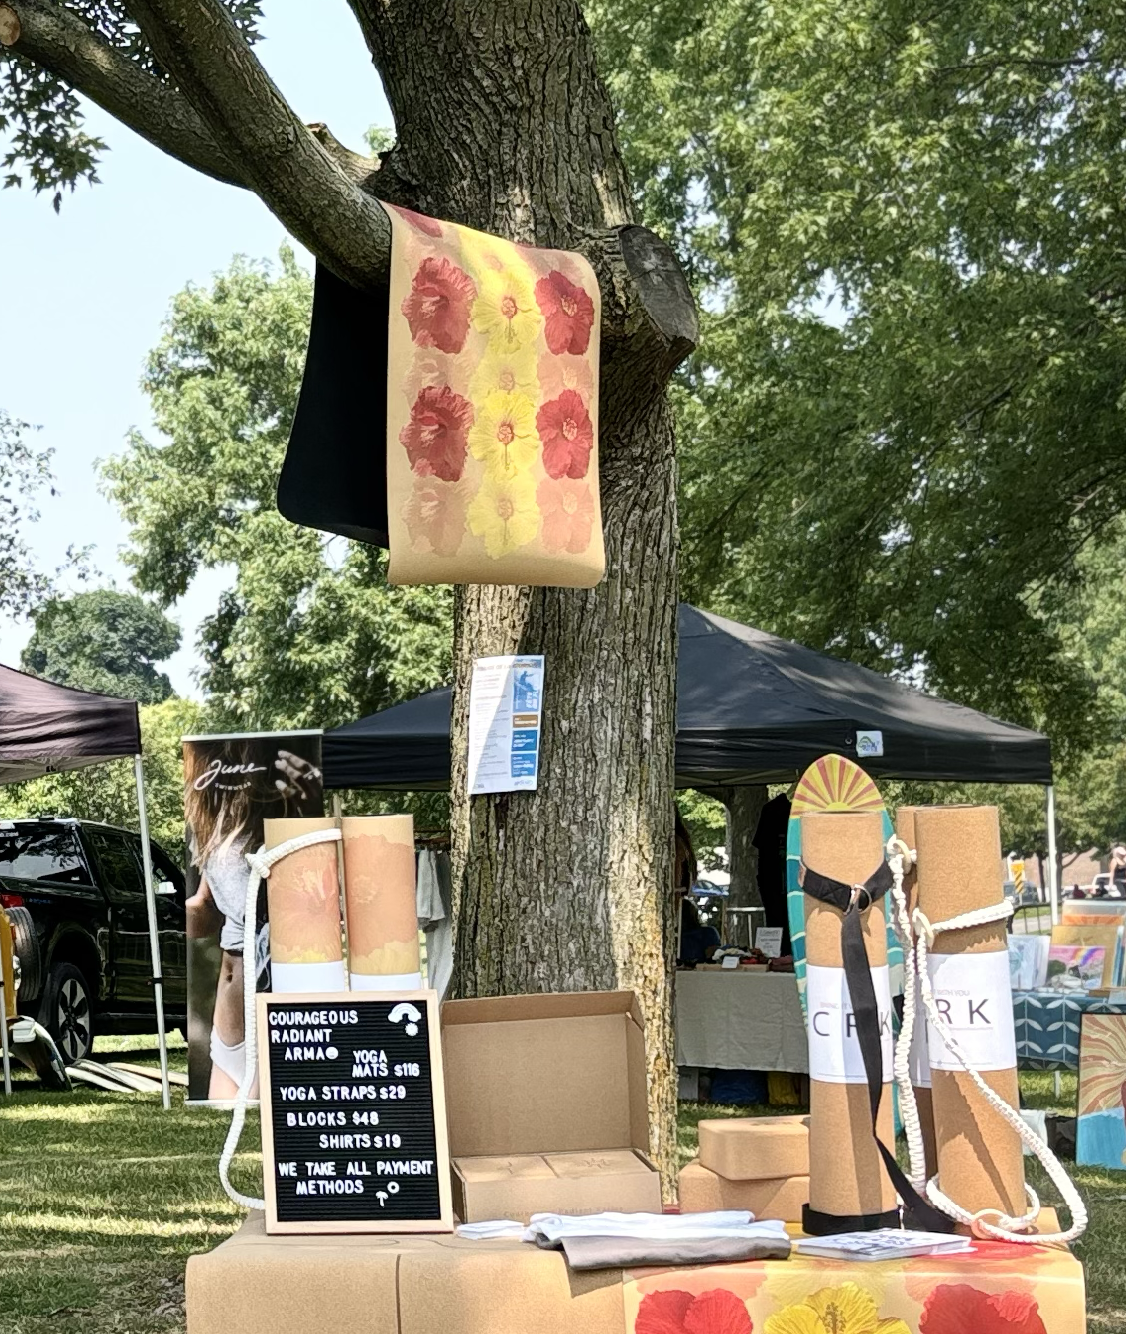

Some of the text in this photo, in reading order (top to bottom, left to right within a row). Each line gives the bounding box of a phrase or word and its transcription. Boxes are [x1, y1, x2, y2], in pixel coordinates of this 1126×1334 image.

[194, 759, 267, 791] June
[269, 1010, 359, 1026] COURAGEOUS
[271, 1029, 333, 1043] RADIANT
[353, 1050, 388, 1064] YOGA
[352, 1063, 389, 1078] MATS
[280, 1087, 317, 1101] YOGA
[321, 1085, 377, 1100] STRAPS
[286, 1110, 380, 1127] BLOCKS $48
[318, 1133, 372, 1149] SHIRTS
[279, 1160, 434, 1177] WE TAKE ALL PAYMENT
[295, 1179, 365, 1196] METHODS
